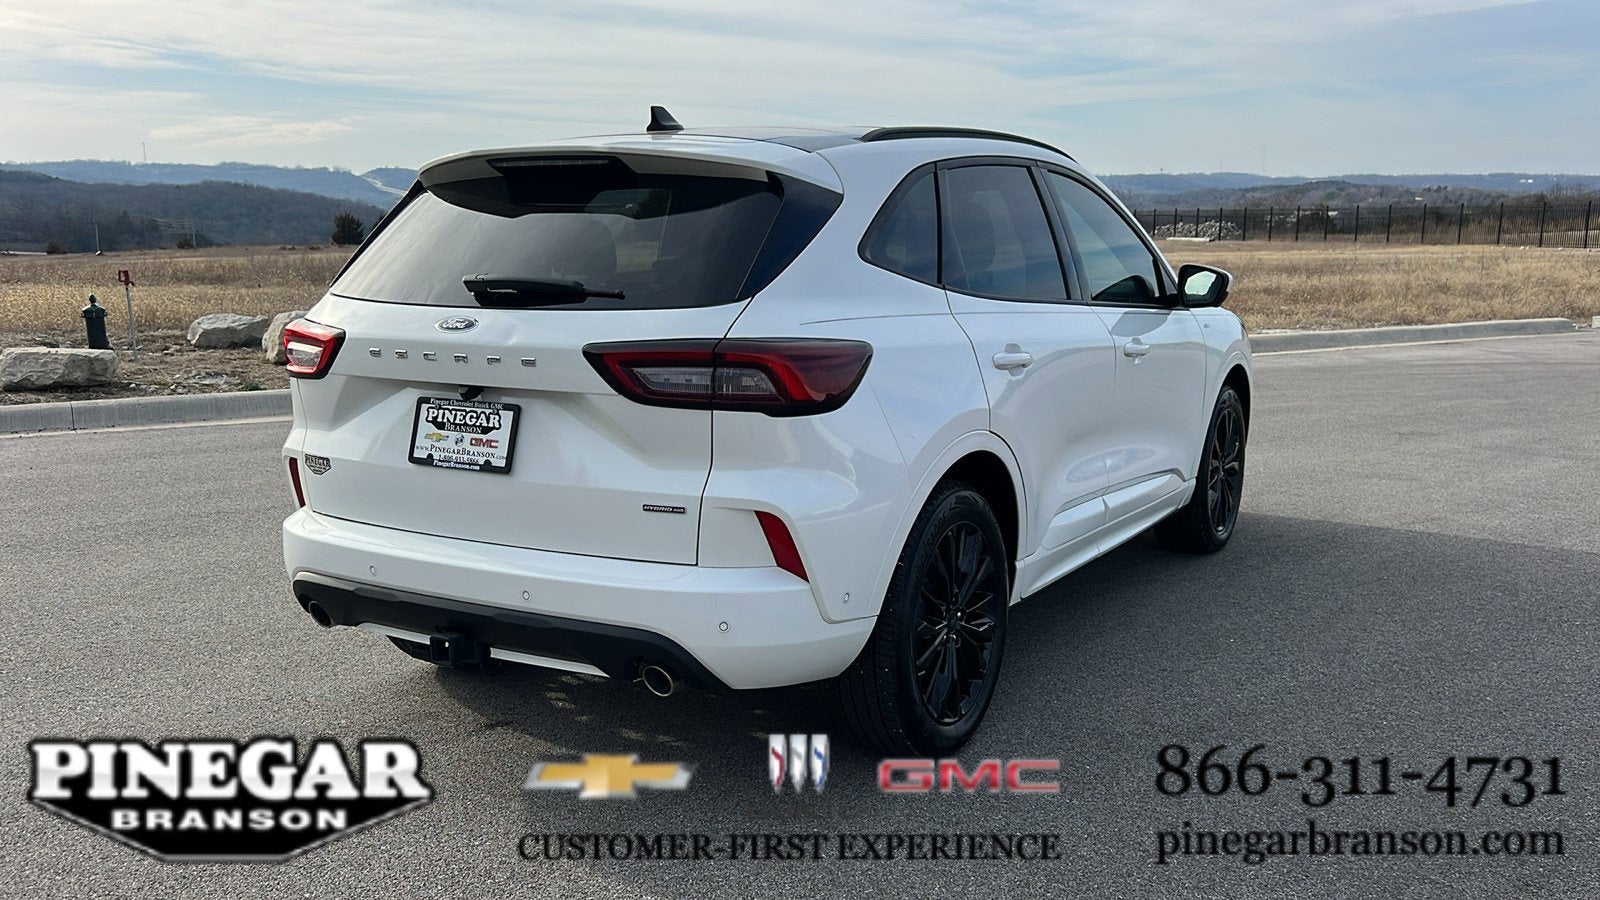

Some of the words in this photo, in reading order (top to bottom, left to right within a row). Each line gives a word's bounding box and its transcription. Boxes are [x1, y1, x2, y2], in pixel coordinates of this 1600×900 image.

[369, 348, 536, 368] ESCAPE
[450, 399, 474, 408] Chevrolet
[427, 408, 500, 428] PINEGAR
[470, 437, 499, 449] GMC
